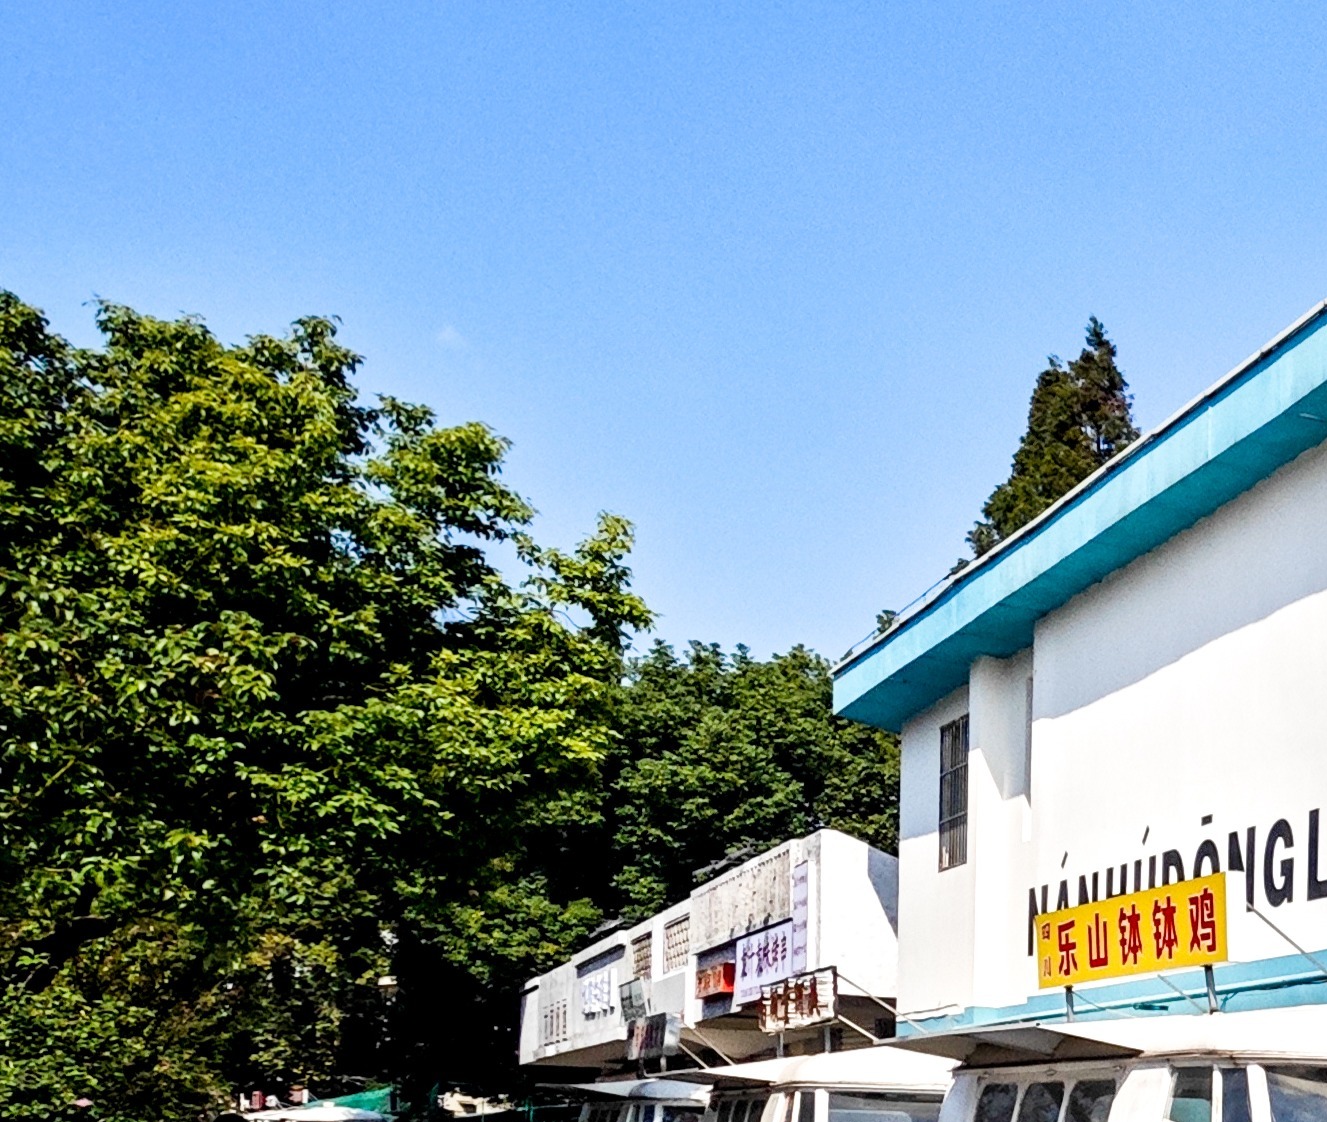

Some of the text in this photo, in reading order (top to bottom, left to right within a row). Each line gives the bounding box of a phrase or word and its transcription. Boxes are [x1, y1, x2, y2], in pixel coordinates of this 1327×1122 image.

[1057, 887, 1218, 977] 乐山钵钵鸡
